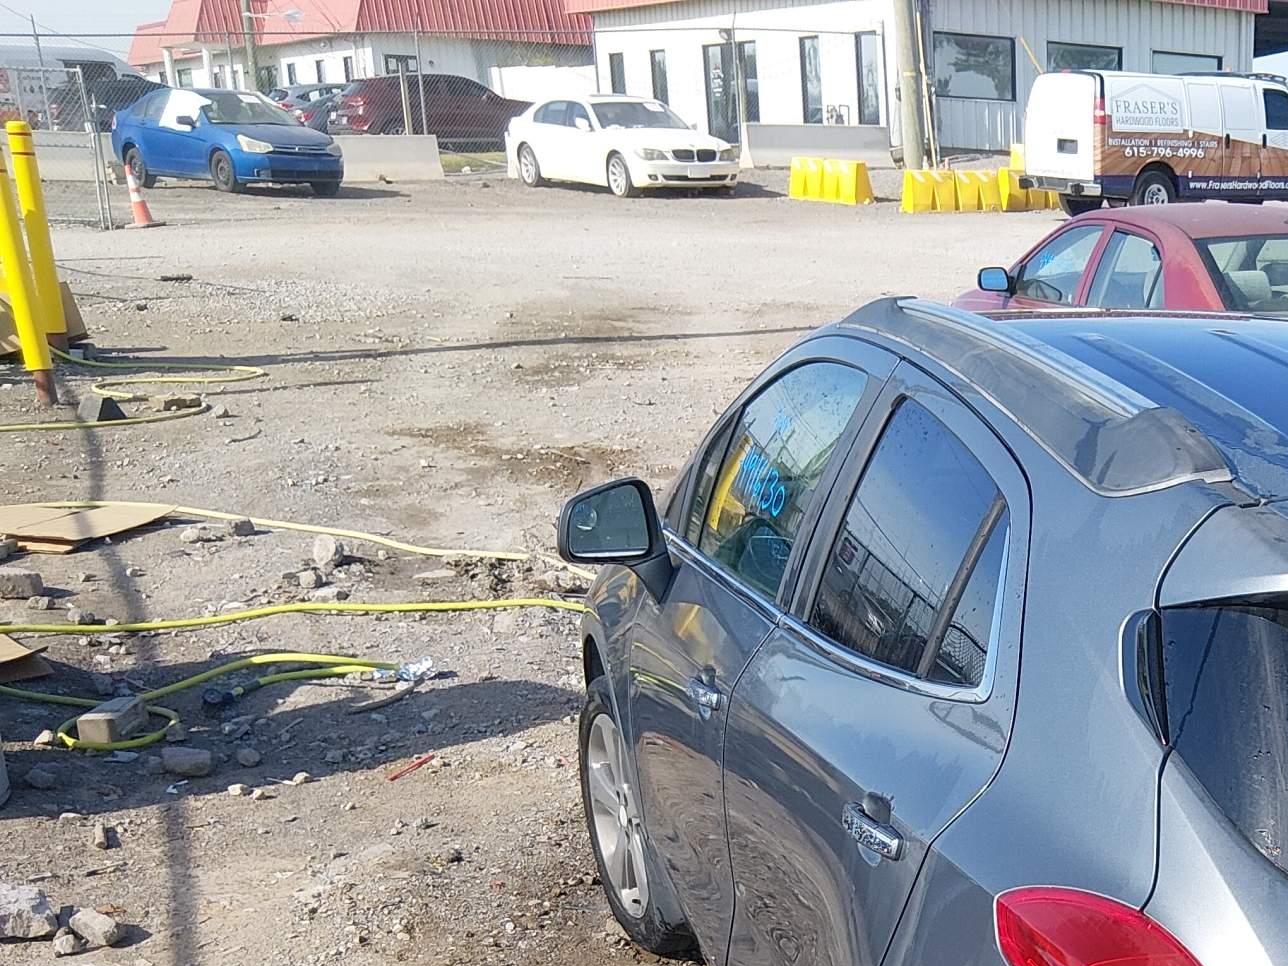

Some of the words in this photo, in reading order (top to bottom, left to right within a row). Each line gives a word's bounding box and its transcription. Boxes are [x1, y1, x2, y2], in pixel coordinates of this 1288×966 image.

[1115, 100, 1179, 115] FRASER'S
[1116, 116, 1154, 126] HARDWOOD
[1155, 117, 1179, 127] FLOORS
[1108, 138, 1149, 147] INSTALLATION
[1124, 147, 1205, 158] 615-796-4996
